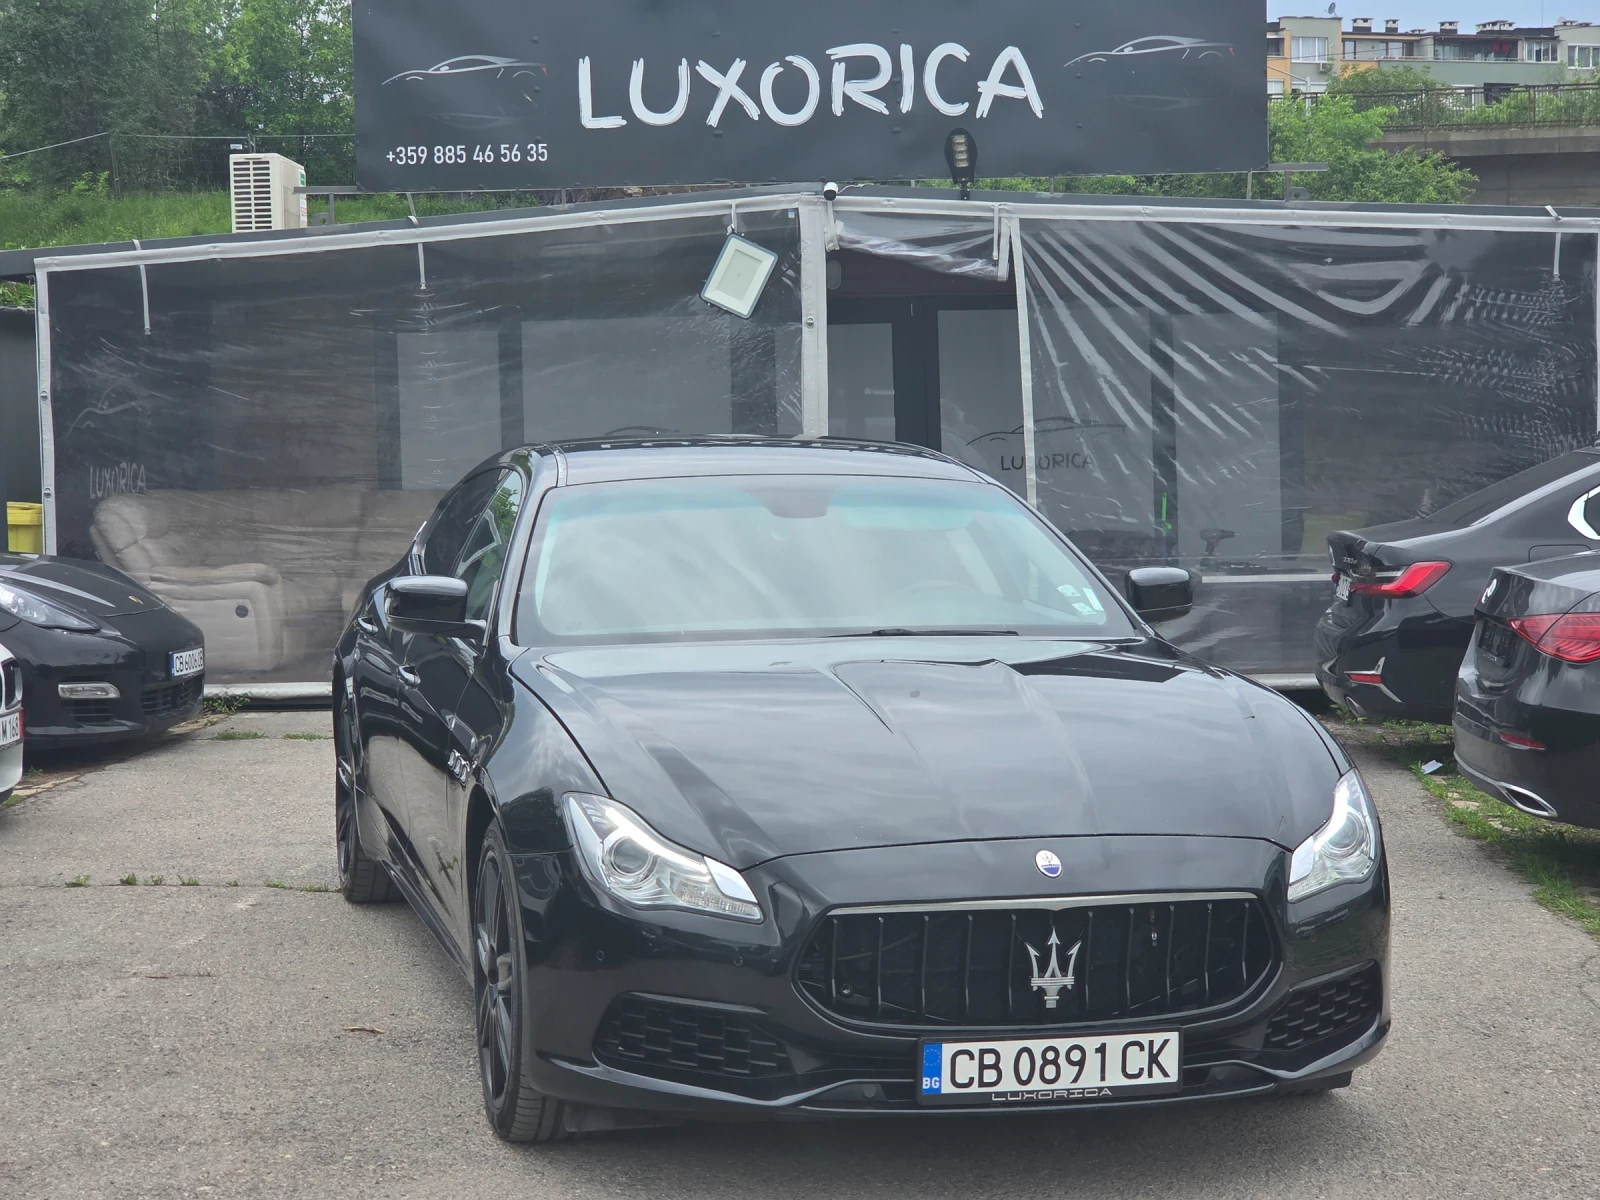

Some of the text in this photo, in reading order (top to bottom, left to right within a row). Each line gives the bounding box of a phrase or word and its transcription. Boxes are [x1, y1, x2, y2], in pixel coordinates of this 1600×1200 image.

[578, 42, 1044, 129] LUXORICA
[386, 143, 548, 165] +359 885 46 56 35
[1000, 452, 1093, 471] LUORICA
[89, 461, 147, 499] LUXORICA
[949, 1038, 1171, 1089] CB 0891 CK
[922, 1077, 940, 1090] BG
[991, 1087, 1113, 1101] LUXORICA
